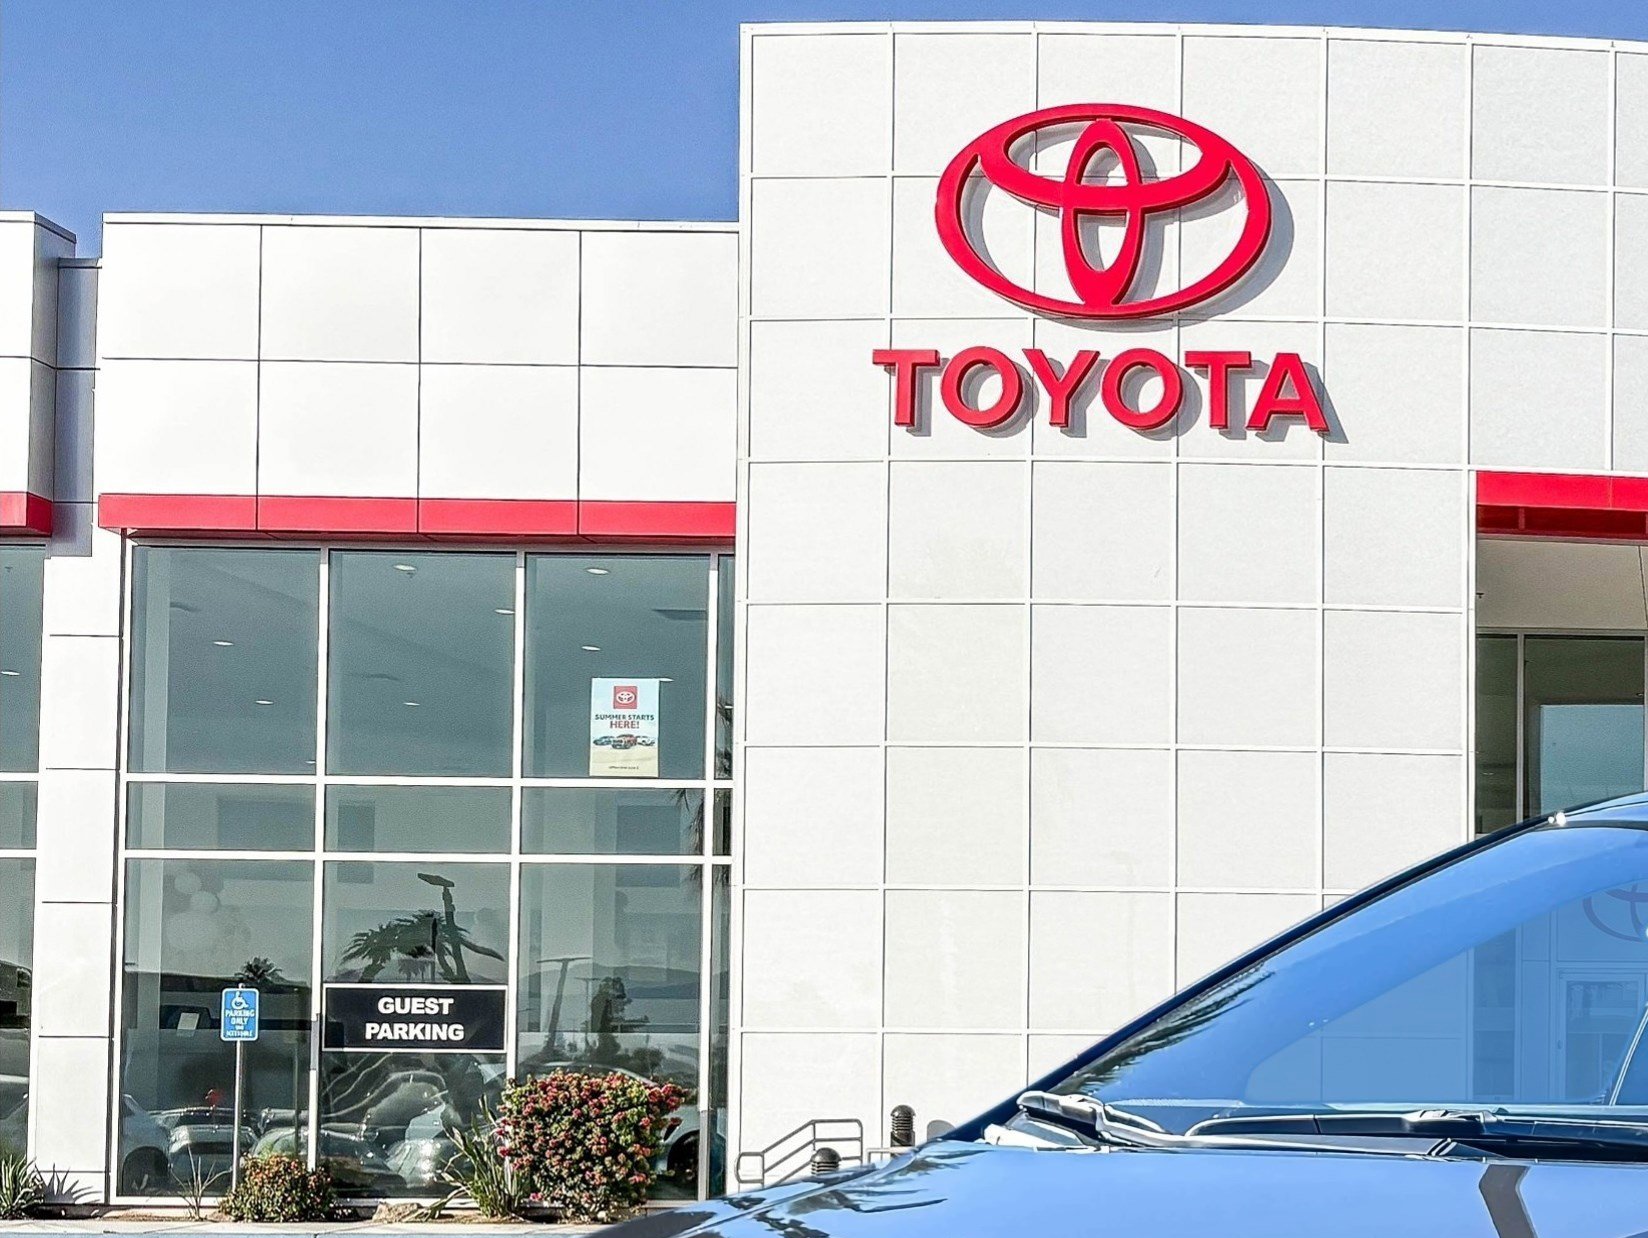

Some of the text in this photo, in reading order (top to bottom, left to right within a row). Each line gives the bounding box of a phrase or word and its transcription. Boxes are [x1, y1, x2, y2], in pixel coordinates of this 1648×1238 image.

[873, 346, 1330, 432] TOYOTA
[610, 721, 640, 729] HERE!
[378, 997, 454, 1015] GUEST
[365, 1022, 465, 1041] PARKING
